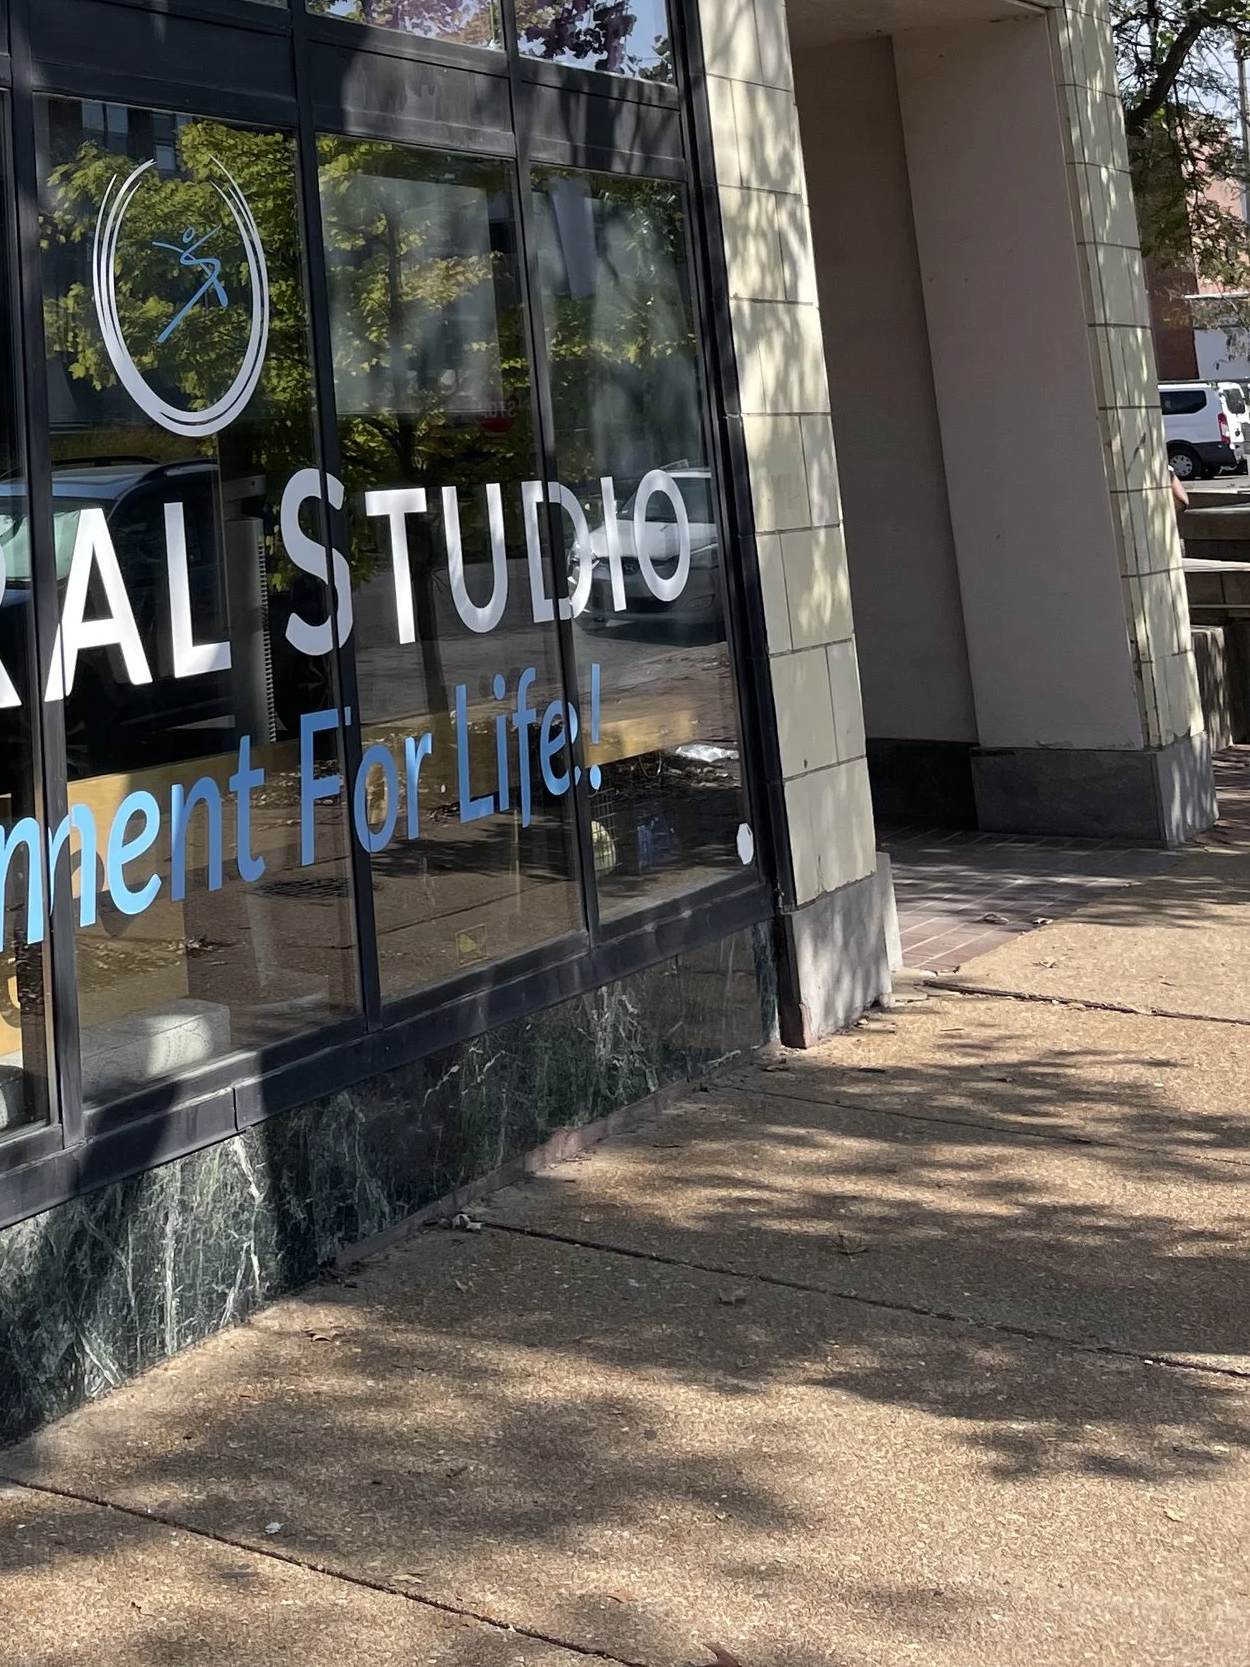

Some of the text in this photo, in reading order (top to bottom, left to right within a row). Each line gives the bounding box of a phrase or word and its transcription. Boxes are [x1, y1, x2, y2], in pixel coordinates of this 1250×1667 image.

[283, 468, 691, 657] STUDIO
[299, 708, 433, 865] For
[455, 663, 602, 829] Life!
